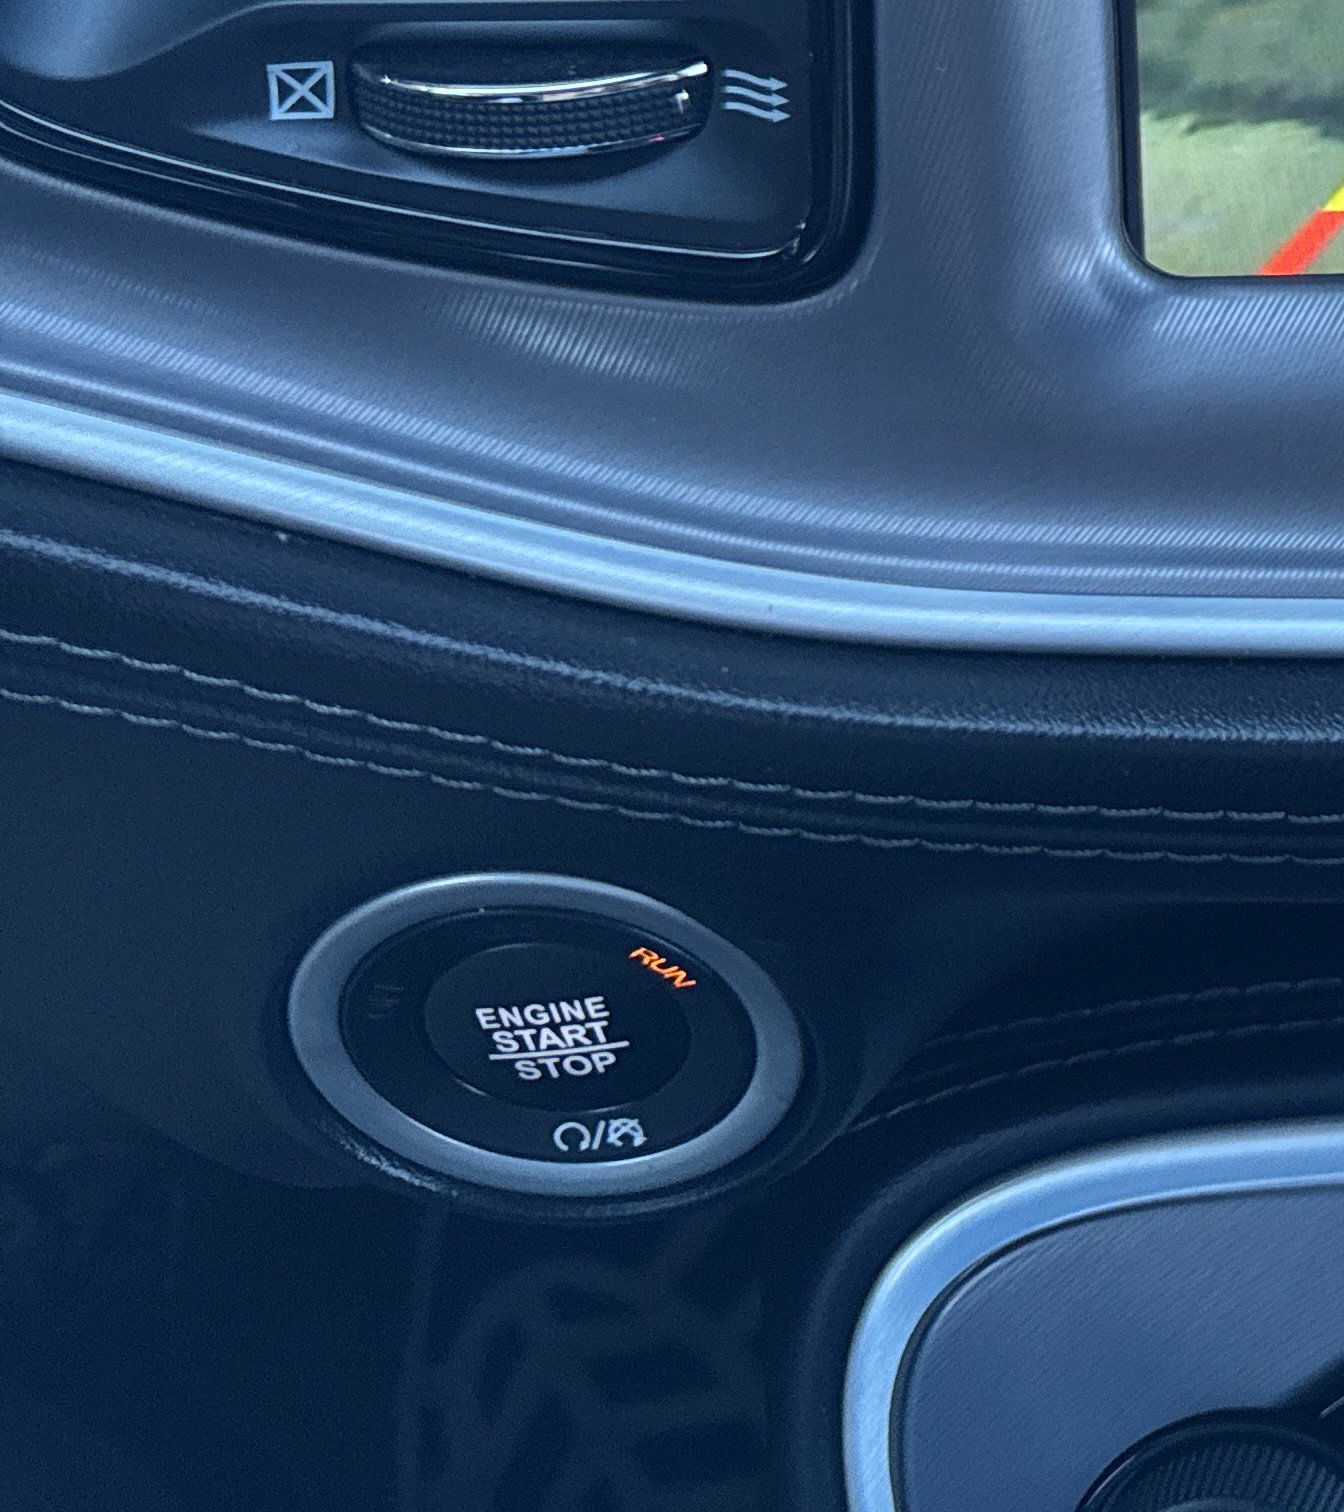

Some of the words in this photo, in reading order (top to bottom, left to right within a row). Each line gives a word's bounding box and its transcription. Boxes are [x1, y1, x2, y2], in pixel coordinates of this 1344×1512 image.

[629, 946, 697, 989] RUN
[475, 995, 610, 1030] ENGINE
[492, 1020, 609, 1053] START
[514, 1051, 617, 1081] STOP
